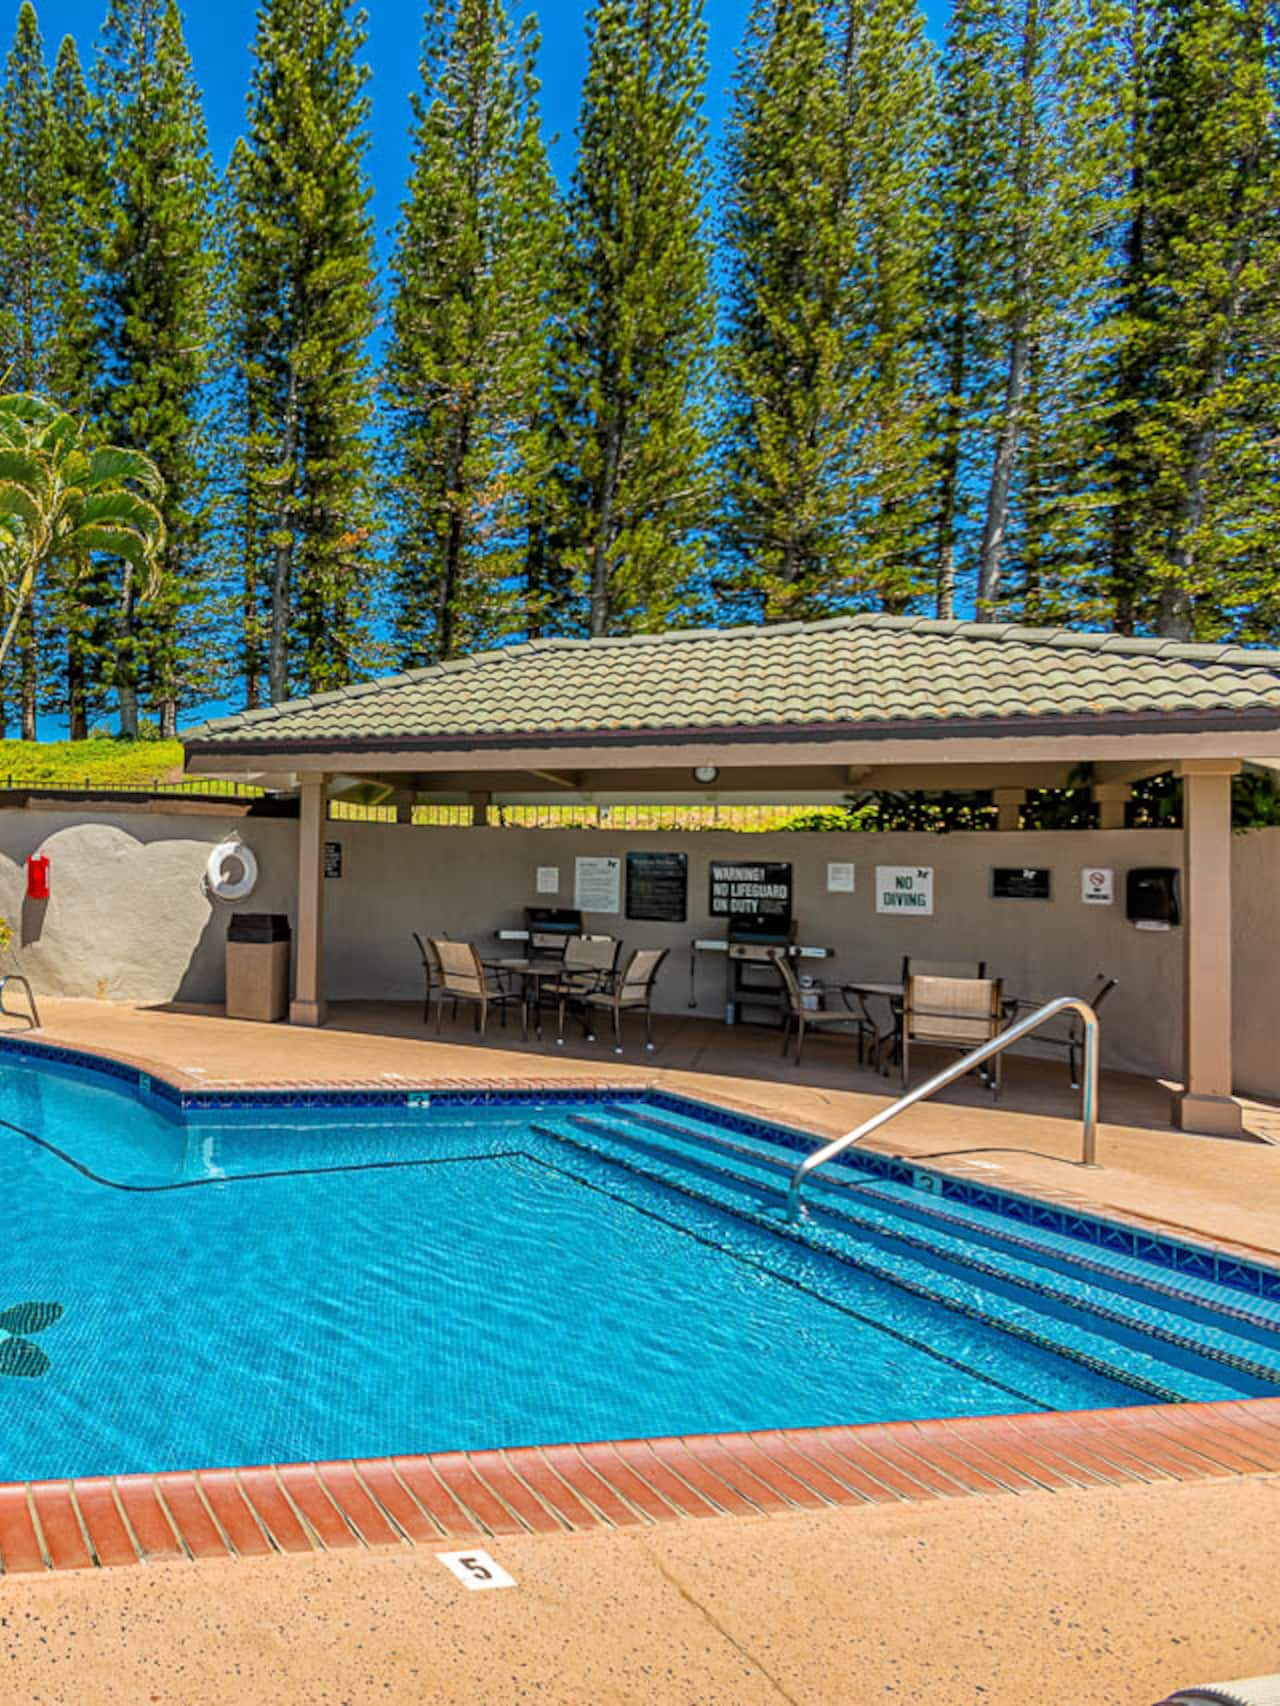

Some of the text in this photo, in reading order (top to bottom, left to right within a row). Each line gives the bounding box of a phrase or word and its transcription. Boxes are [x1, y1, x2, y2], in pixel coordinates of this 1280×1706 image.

[895, 876, 913, 890] NO
[713, 883, 788, 899] NO LIFEGUARD
[713, 898, 728, 912] ON
[730, 898, 759, 913] DUTY
[883, 892, 927, 907] DIVING
[458, 1557, 493, 1580] 5
